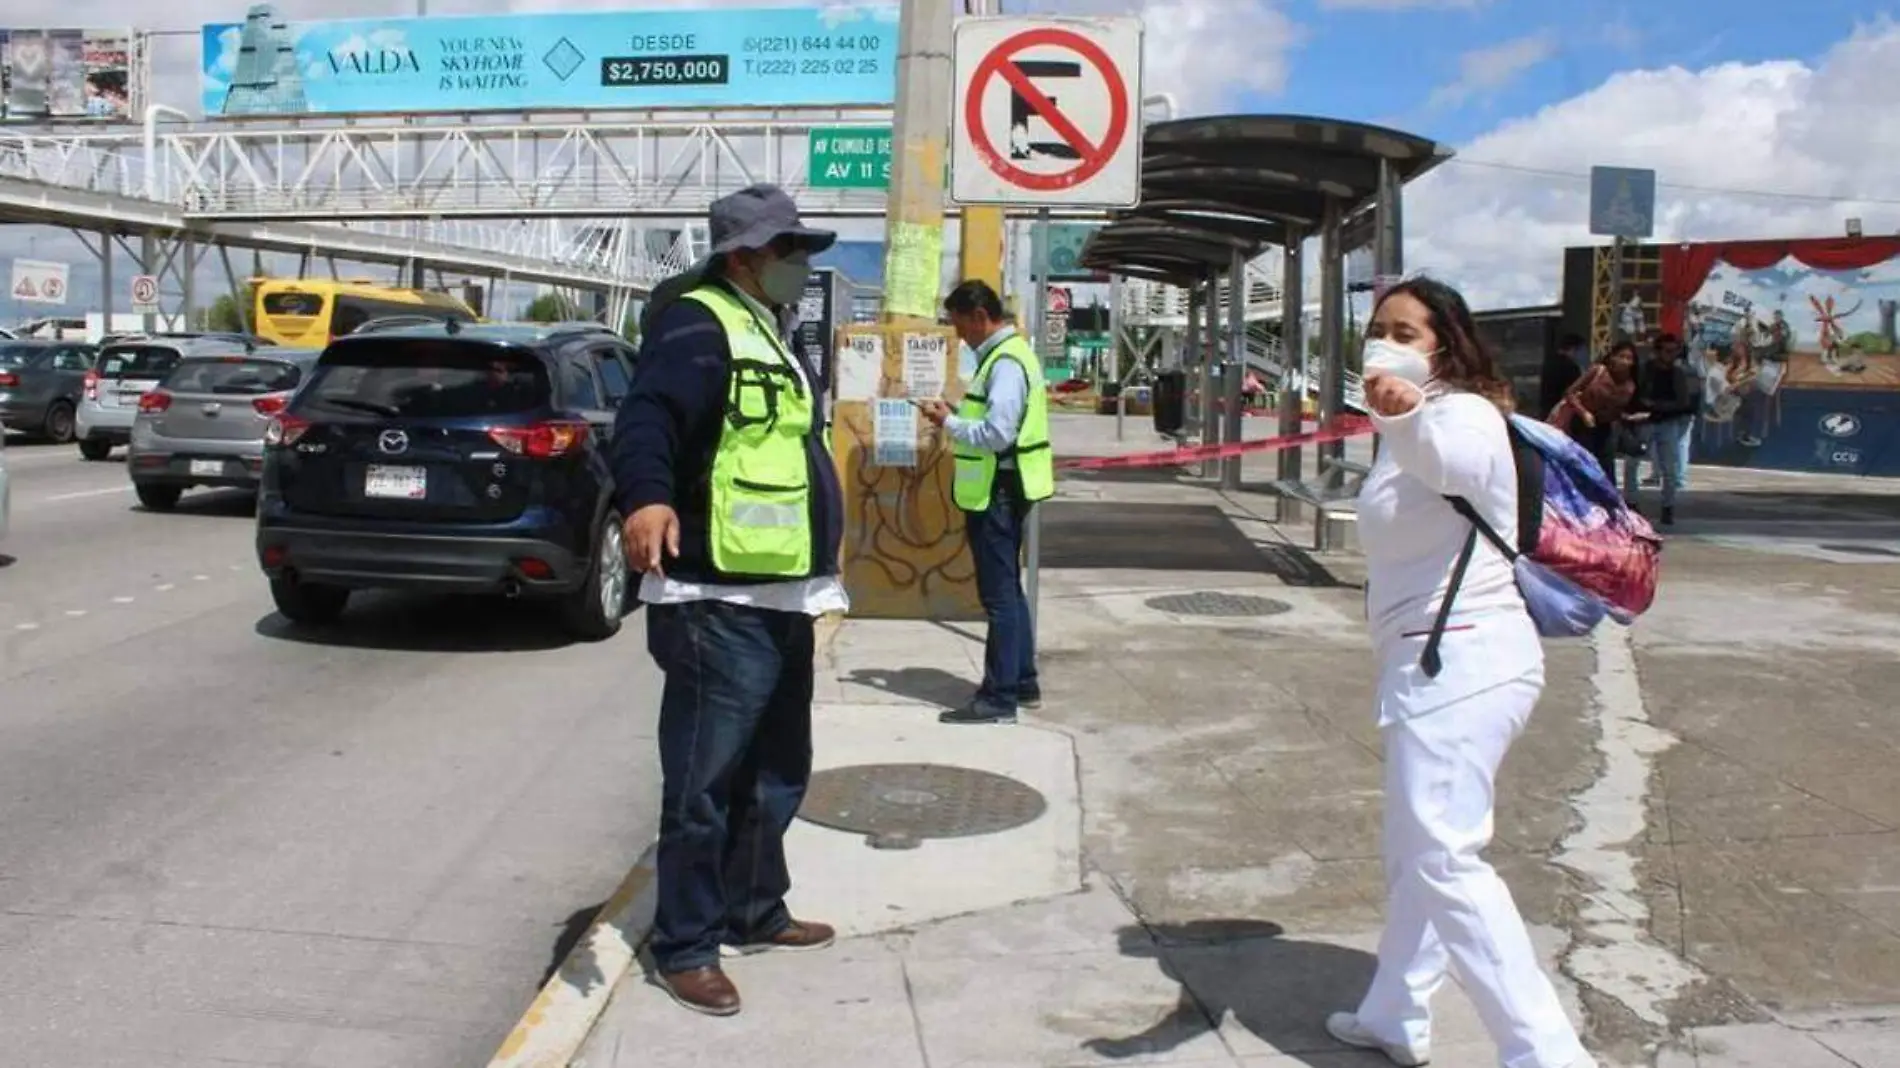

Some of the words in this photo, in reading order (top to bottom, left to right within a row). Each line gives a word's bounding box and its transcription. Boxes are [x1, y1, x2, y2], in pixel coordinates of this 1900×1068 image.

[439, 38, 485, 53] YOUR
[488, 36, 523, 50] NEW
[631, 33, 696, 50] DESDE
[801, 36, 831, 51] 644
[835, 36, 855, 50] 44
[859, 34, 880, 51] 00
[327, 49, 420, 75] VALDA
[440, 53, 524, 71] SKYHOME
[800, 58, 831, 75] 225
[834, 58, 854, 74] 02
[857, 58, 879, 74] 25
[608, 60, 720, 82] $2,750,000
[439, 74, 453, 90] IS
[456, 73, 529, 90] WAITING
[824, 161, 852, 179] AV
[860, 161, 873, 179] 11
[907, 336, 945, 352] TAROT
